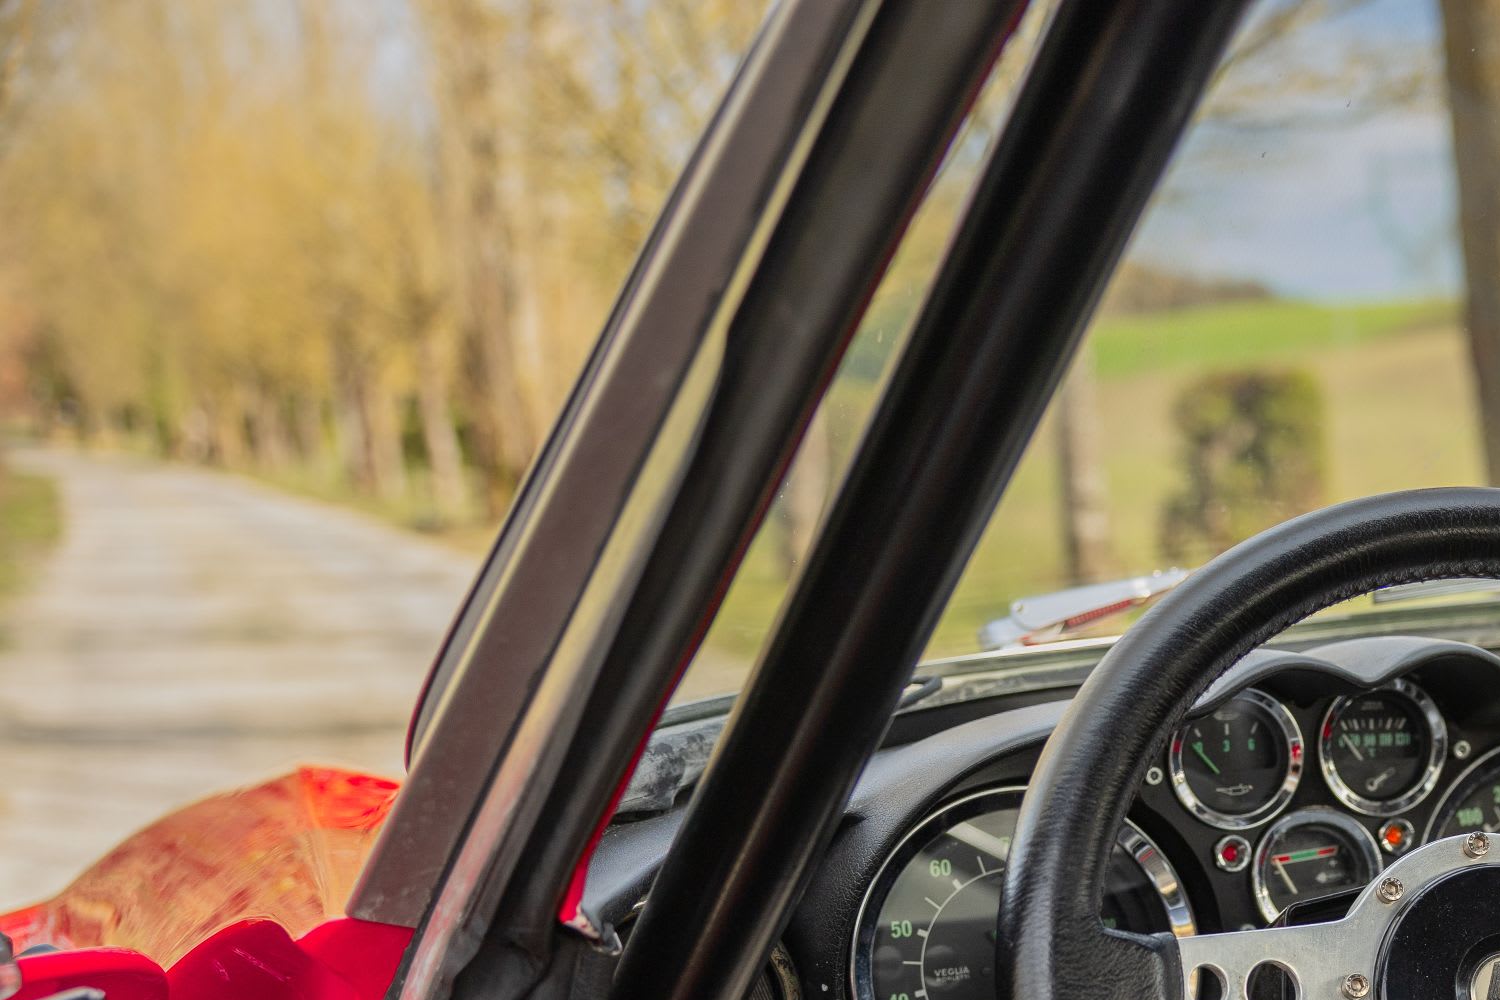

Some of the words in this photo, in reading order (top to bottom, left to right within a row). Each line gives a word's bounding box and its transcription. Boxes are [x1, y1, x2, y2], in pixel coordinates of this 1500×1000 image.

[929, 859, 952, 877] 60
[890, 920, 912, 938] 50
[934, 965, 970, 977] VEGLIA
